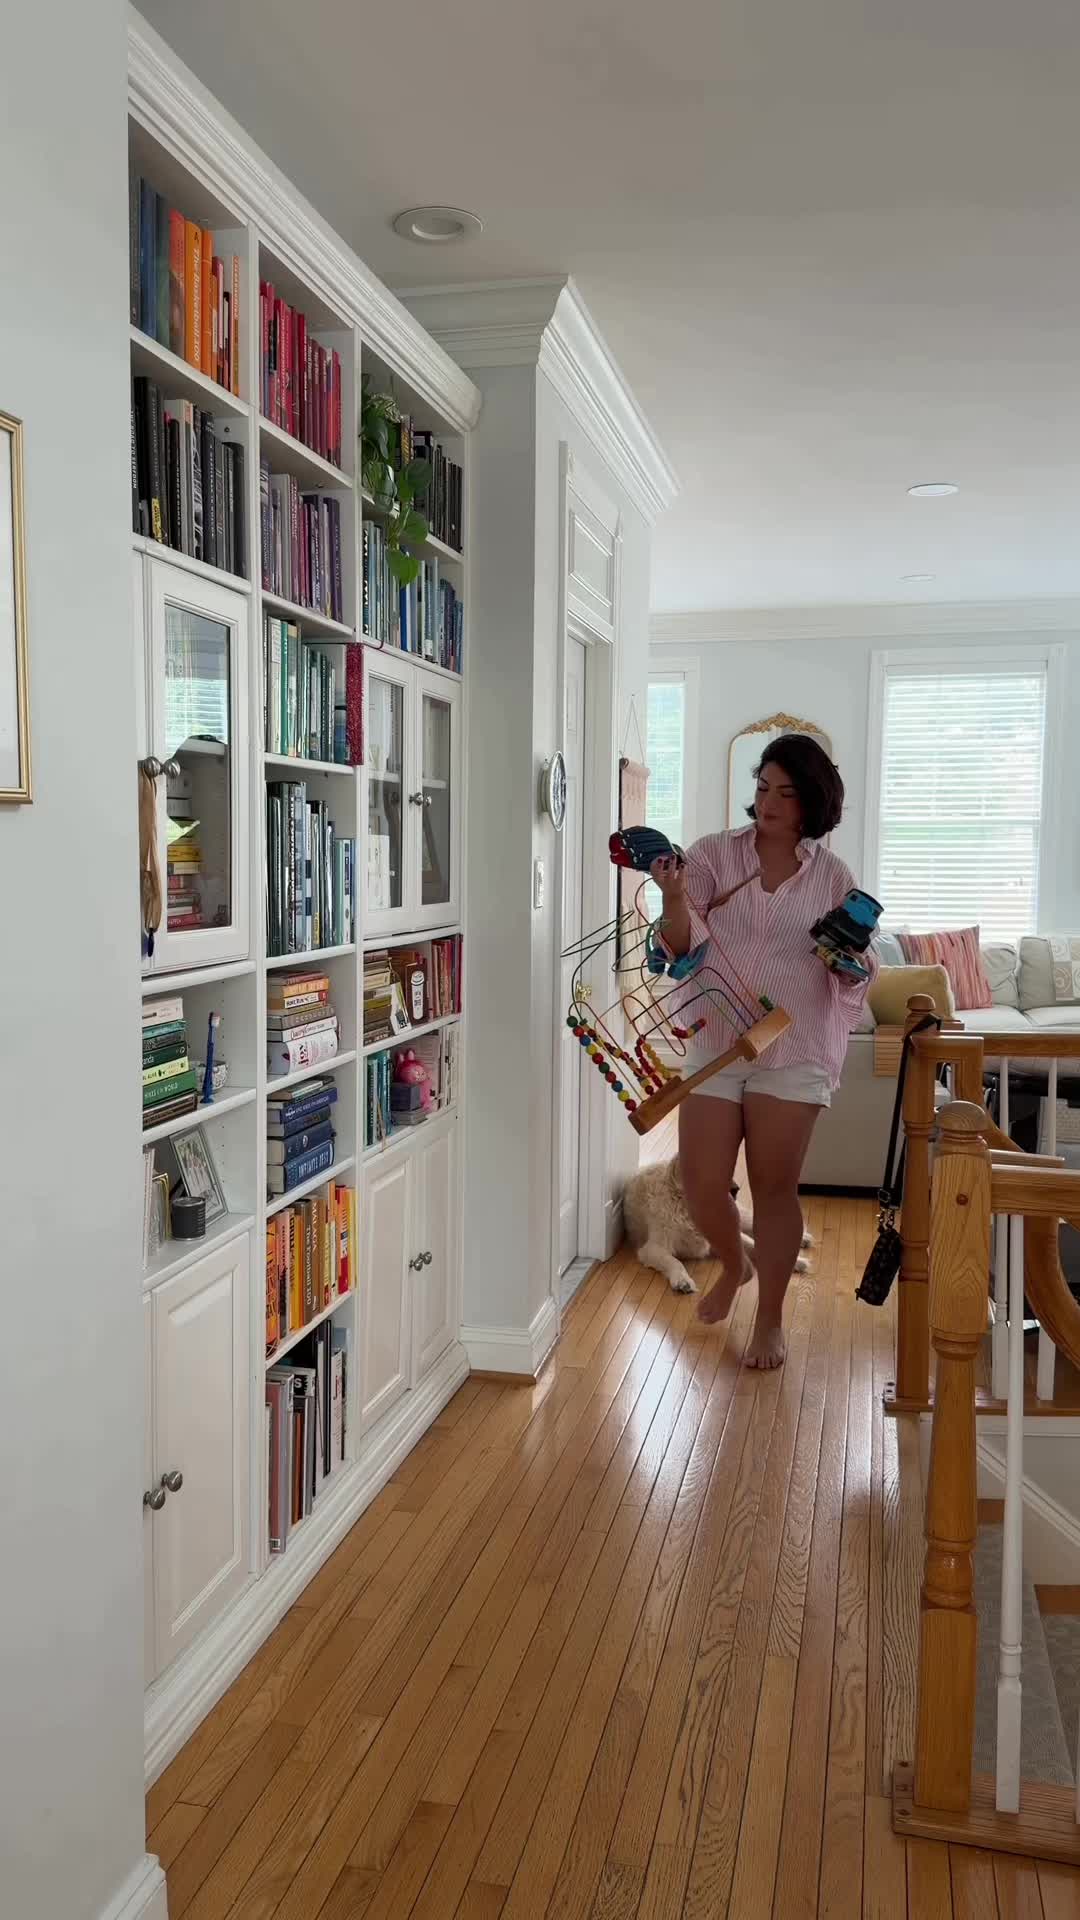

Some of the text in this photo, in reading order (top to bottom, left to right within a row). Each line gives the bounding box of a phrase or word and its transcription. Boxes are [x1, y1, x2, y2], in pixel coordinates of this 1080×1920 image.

[193, 246, 201, 270] The
[193, 273, 201, 336] Basketball
[298, 1152, 329, 1178] INFINITE JEST
